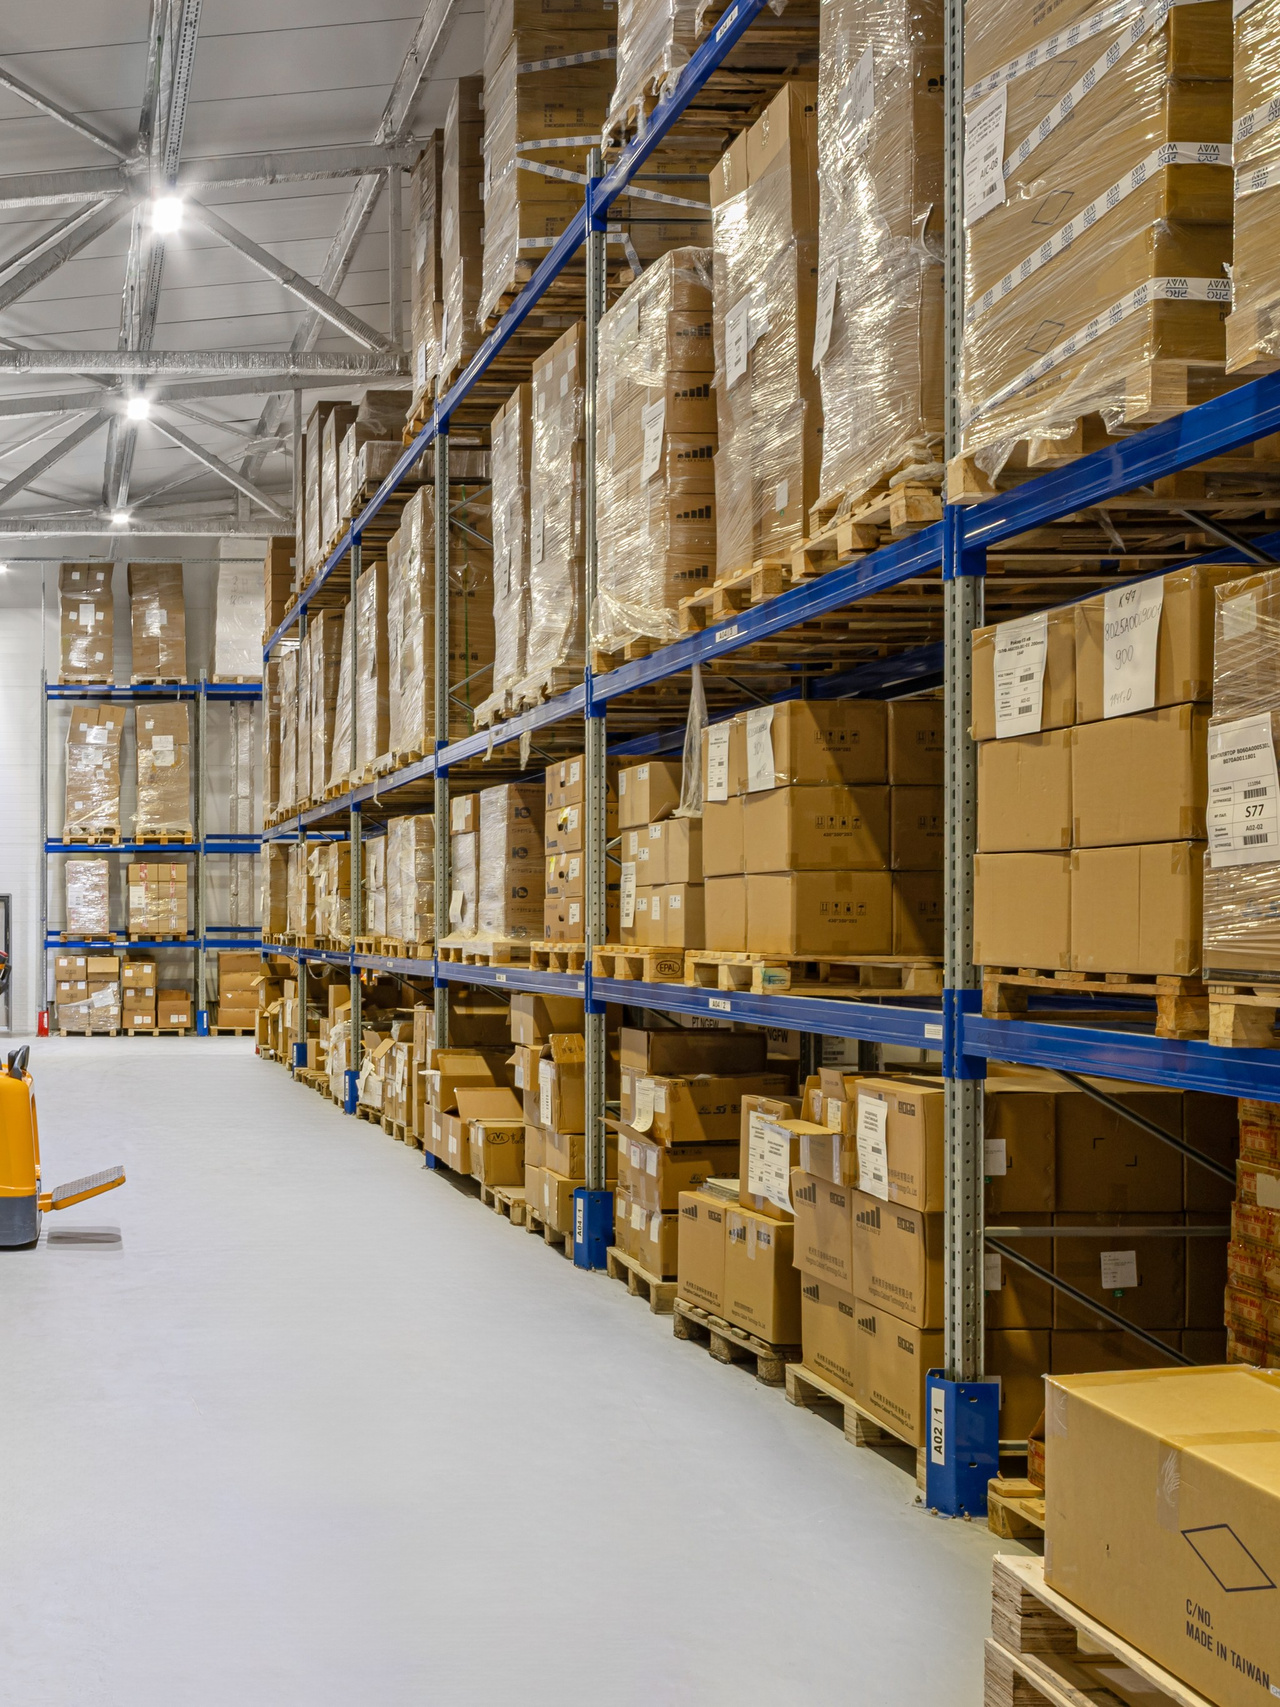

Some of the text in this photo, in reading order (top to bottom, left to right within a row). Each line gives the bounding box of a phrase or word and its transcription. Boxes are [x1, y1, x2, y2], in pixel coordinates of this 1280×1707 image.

[1238, 113, 1255, 128] WAY
[1237, 125, 1253, 141] PRO
[1158, 144, 1178, 157] WAY
[1158, 154, 1176, 167] PRO
[1166, 279, 1188, 287] WAY
[1207, 280, 1231, 289] WAY
[1133, 284, 1148, 298] WAY
[1165, 289, 1187, 298] PRO
[1207, 291, 1229, 300] PRO
[1133, 294, 1148, 309] PRO
[1245, 804, 1264, 818] S77
[659, 962, 677, 972] EPAL
[933, 1424, 943, 1455] A02
[1186, 1599, 1214, 1630] C/NO.
[1186, 1620, 1270, 1690] MADE IN TAIWAN
